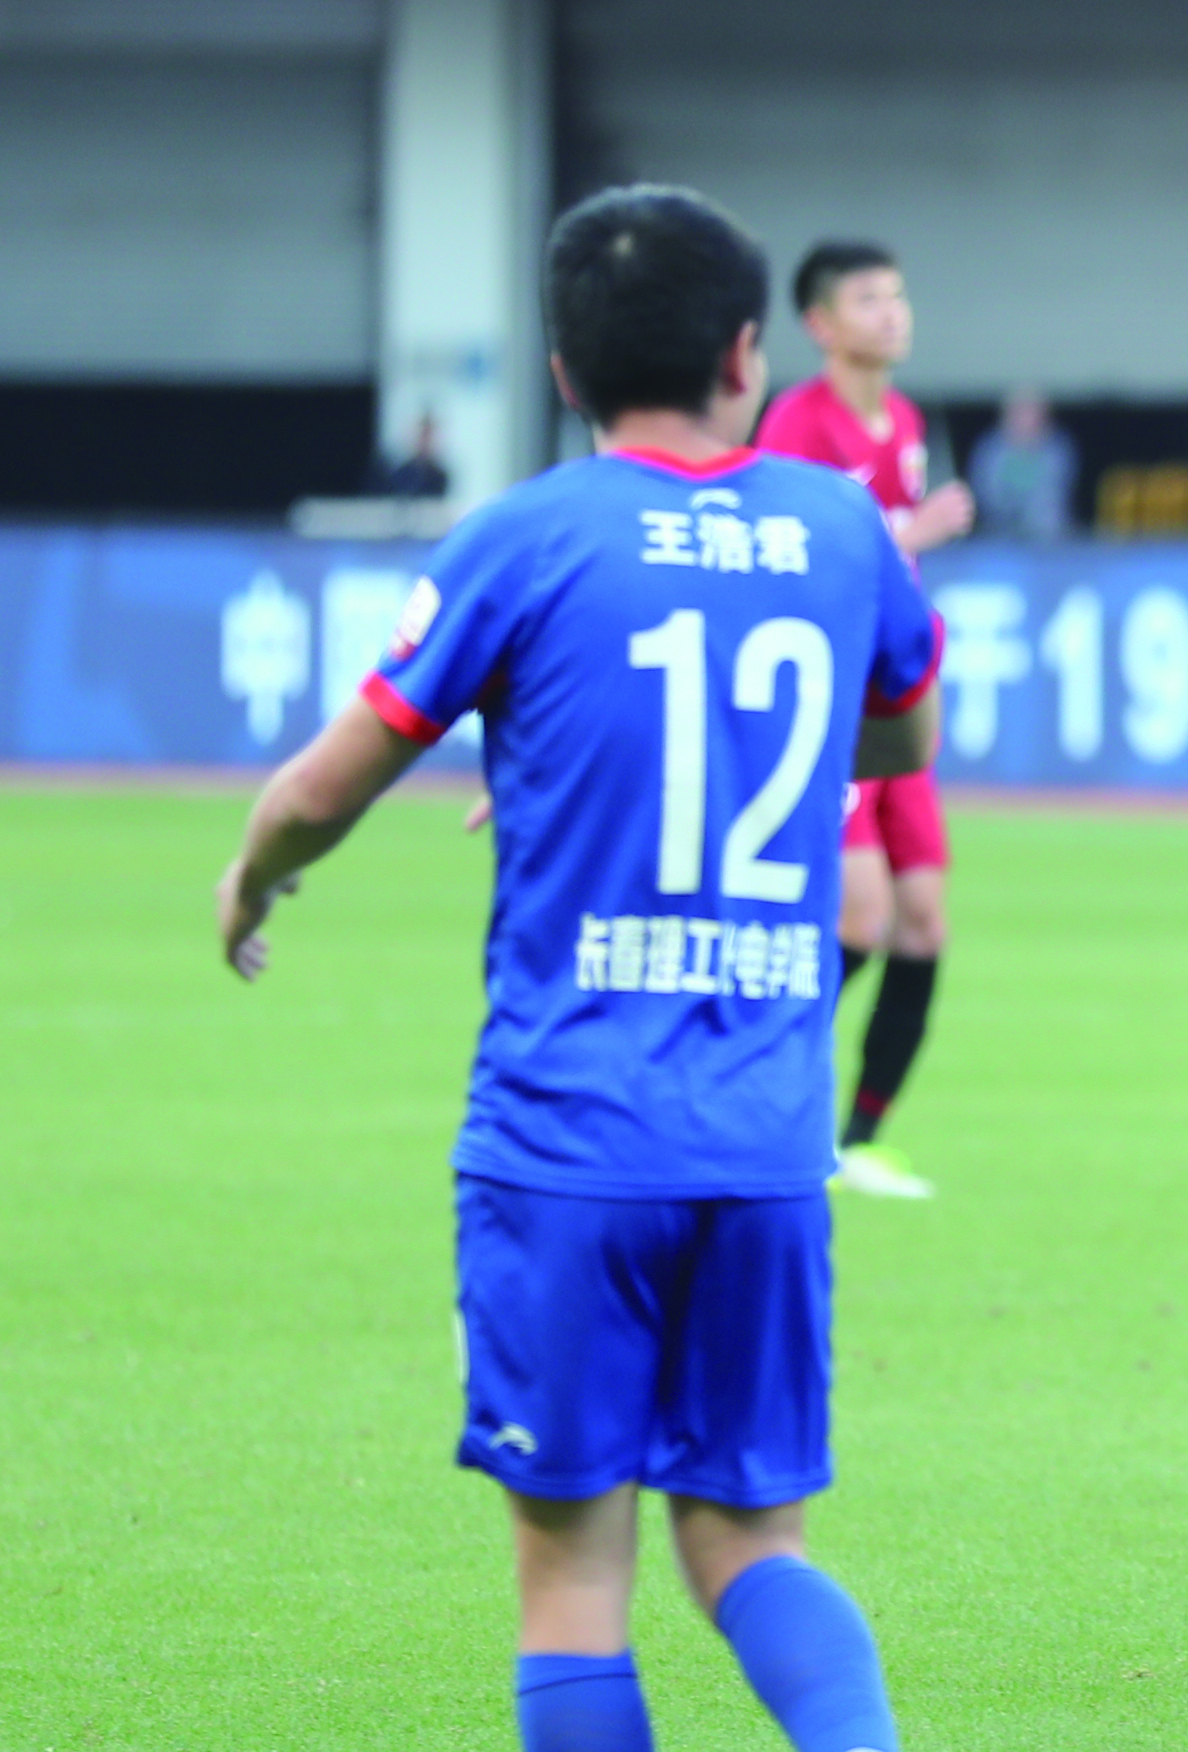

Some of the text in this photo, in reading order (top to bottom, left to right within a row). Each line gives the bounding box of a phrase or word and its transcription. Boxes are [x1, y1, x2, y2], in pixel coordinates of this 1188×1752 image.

[639, 510, 811, 575] 王浩君
[628, 610, 834, 903] 12
